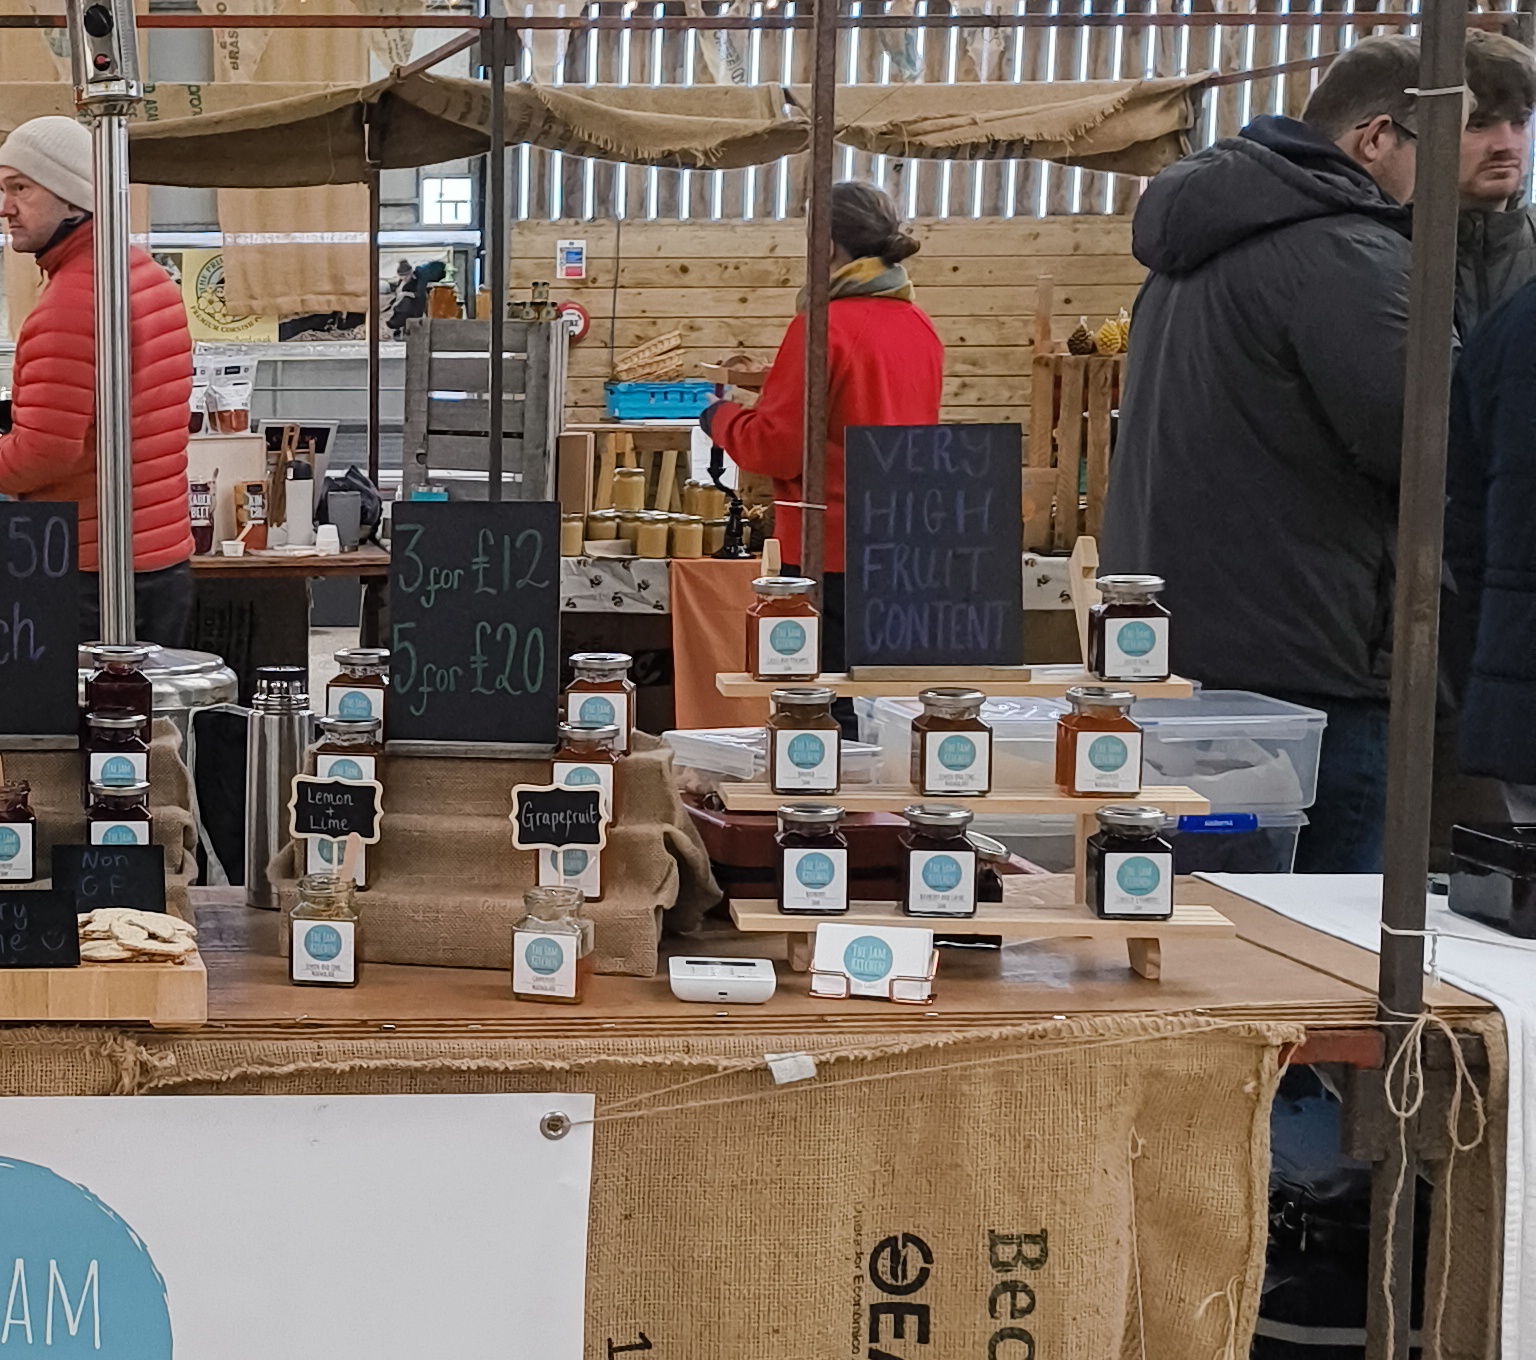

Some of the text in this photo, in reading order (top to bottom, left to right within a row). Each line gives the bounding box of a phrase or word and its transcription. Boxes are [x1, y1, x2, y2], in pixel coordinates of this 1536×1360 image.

[865, 427, 992, 477] VERY
[864, 488, 993, 536] HIGH
[394, 523, 550, 608] 3 for £12
[863, 543, 994, 591] FRUIT
[864, 597, 1013, 653] CONTENT
[391, 621, 545, 716] 5 for £20
[307, 790, 354, 806] Lemon
[521, 801, 598, 838] Grapefruit
[309, 815, 349, 831] Lime
[82, 850, 129, 867] Non
